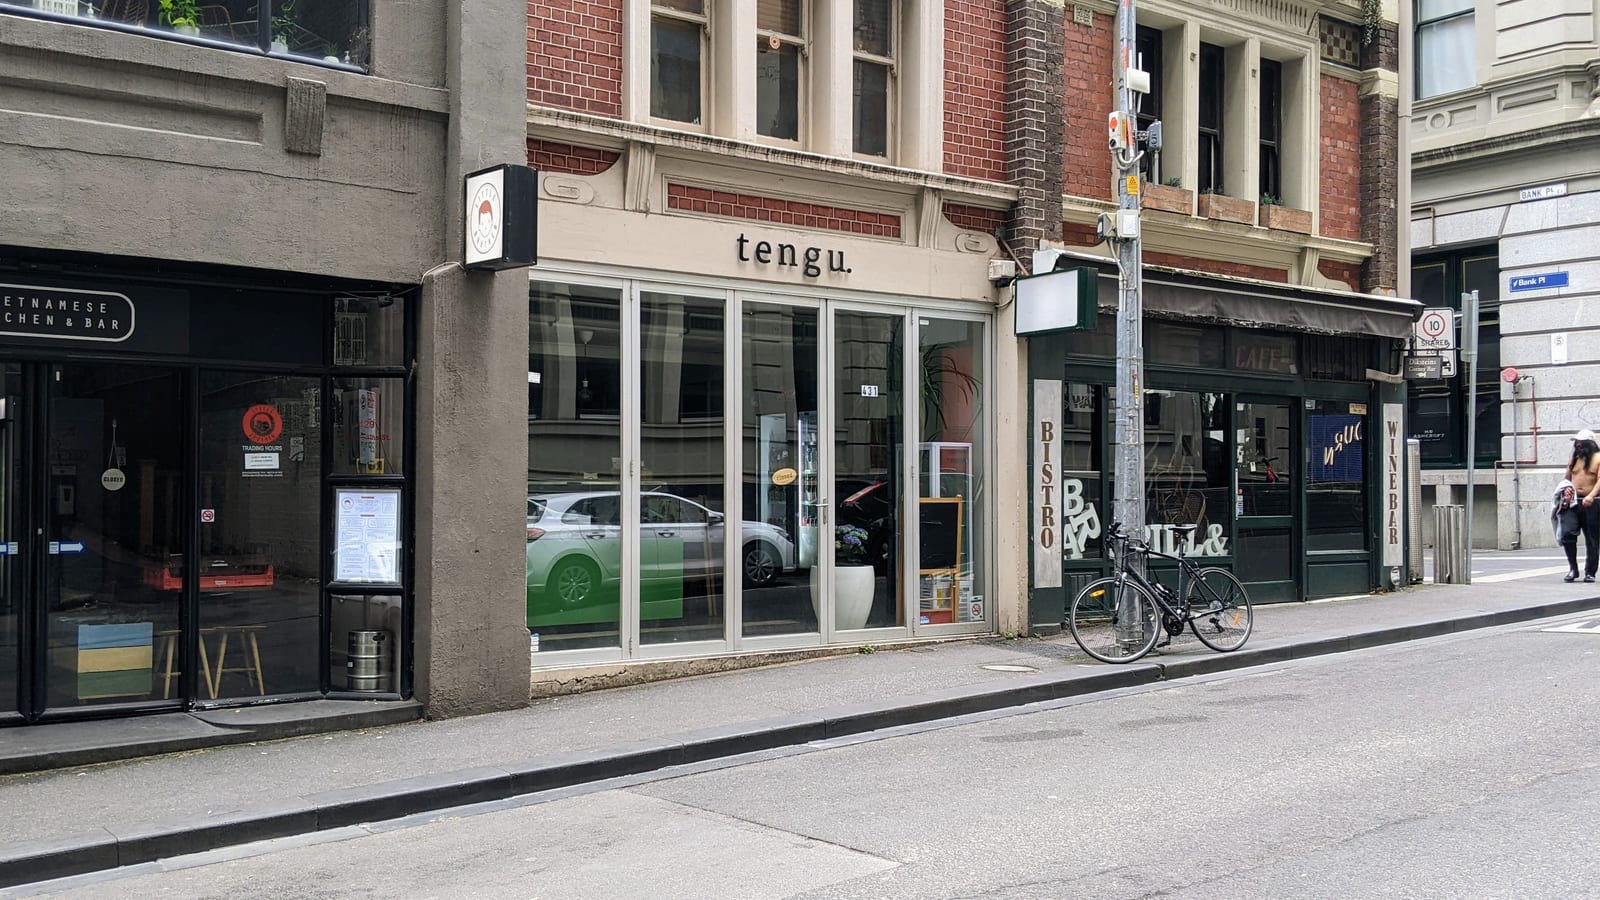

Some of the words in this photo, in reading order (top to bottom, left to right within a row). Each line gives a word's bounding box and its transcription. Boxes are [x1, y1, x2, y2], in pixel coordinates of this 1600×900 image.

[1521, 189, 1542, 200] BANK
[736, 232, 852, 278] tengu.
[1518, 278, 1537, 287] Bank
[4, 295, 107, 314] ETNAMESE
[4, 311, 54, 326] CHEN
[65, 317, 73, 327] &
[84, 317, 119, 330] BAR
[1429, 320, 1440, 331] 10
[862, 385, 877, 396] 431
[1387, 420, 1399, 490] WINE
[1040, 420, 1055, 550] BISTRO
[1388, 493, 1399, 545] BAR
